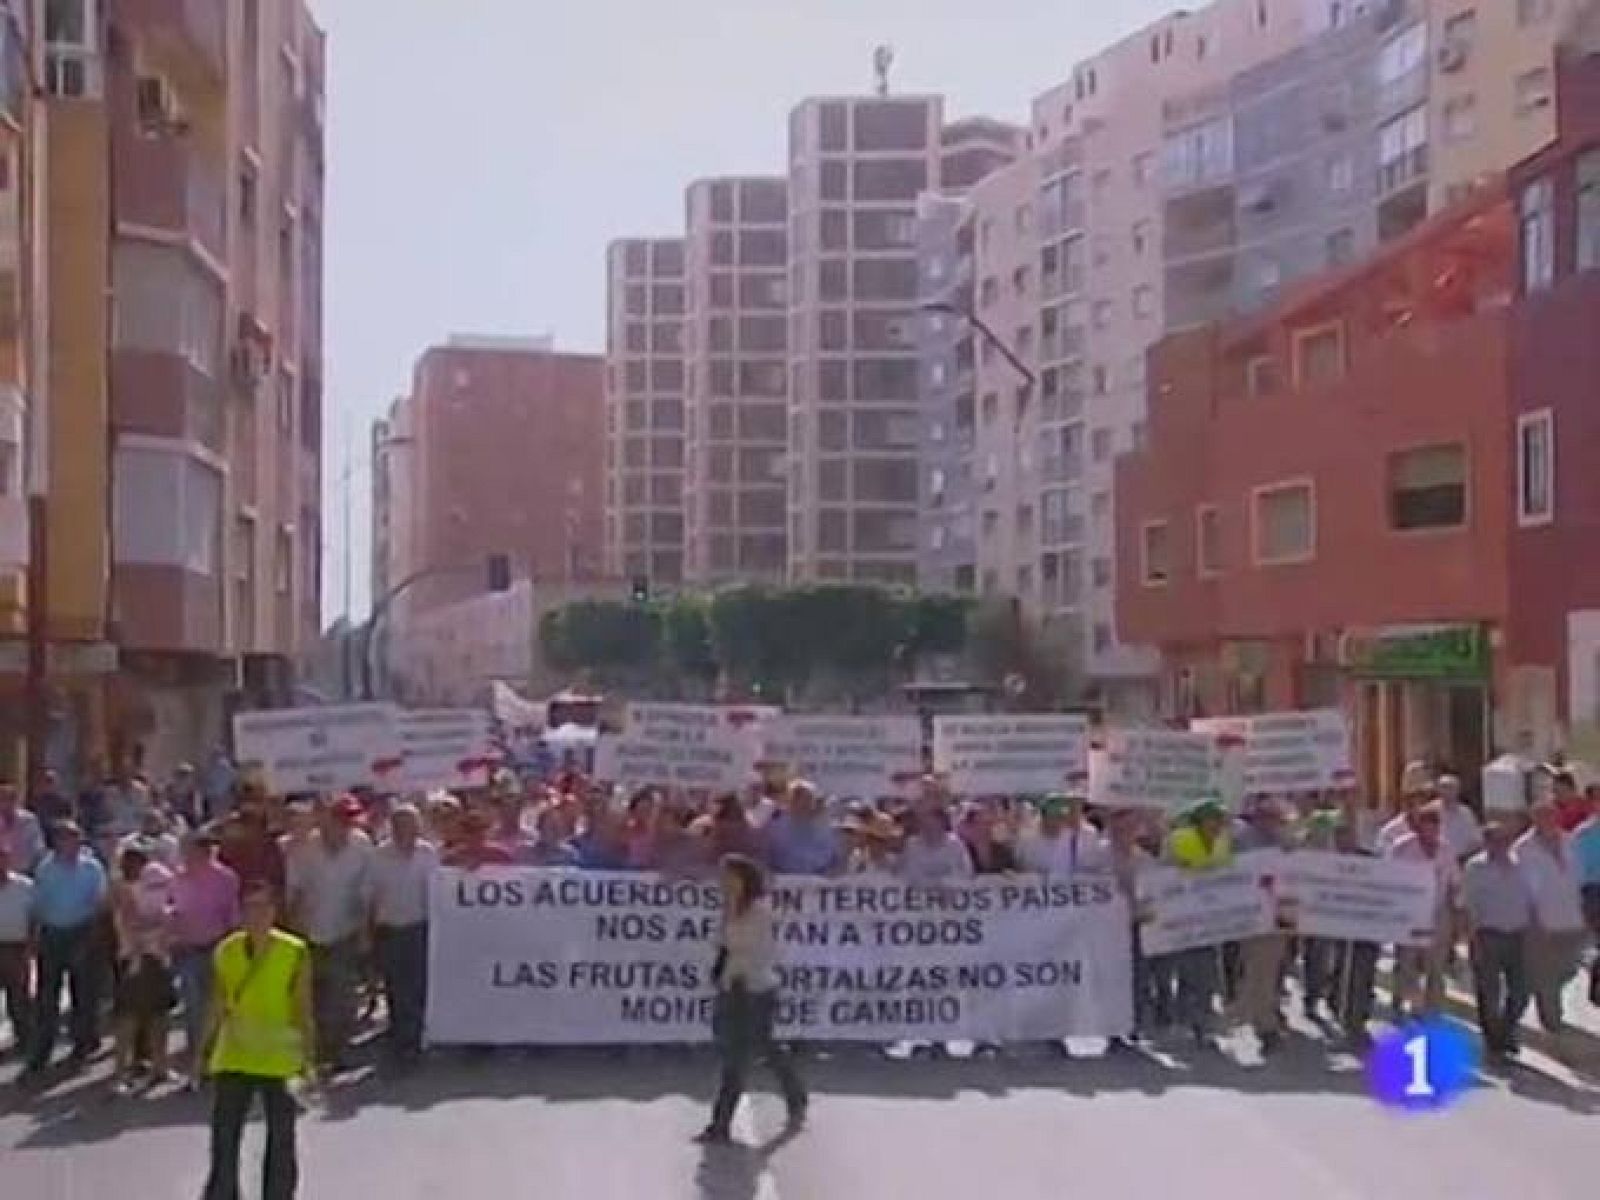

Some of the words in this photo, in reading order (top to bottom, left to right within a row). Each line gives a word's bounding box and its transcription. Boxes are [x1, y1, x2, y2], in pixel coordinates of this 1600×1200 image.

[455, 879, 523, 907] LOS
[533, 880, 720, 910] ACUERDOS
[816, 886, 993, 913] TERCEROS
[596, 914, 667, 942] NOS
[837, 923, 861, 946] A
[871, 919, 984, 946] TODOS
[492, 961, 558, 989] LAS
[568, 961, 700, 990] FRUTAS
[958, 962, 1006, 989] NO
[1014, 960, 1081, 987] SON
[830, 996, 961, 1026] CAMBIO
